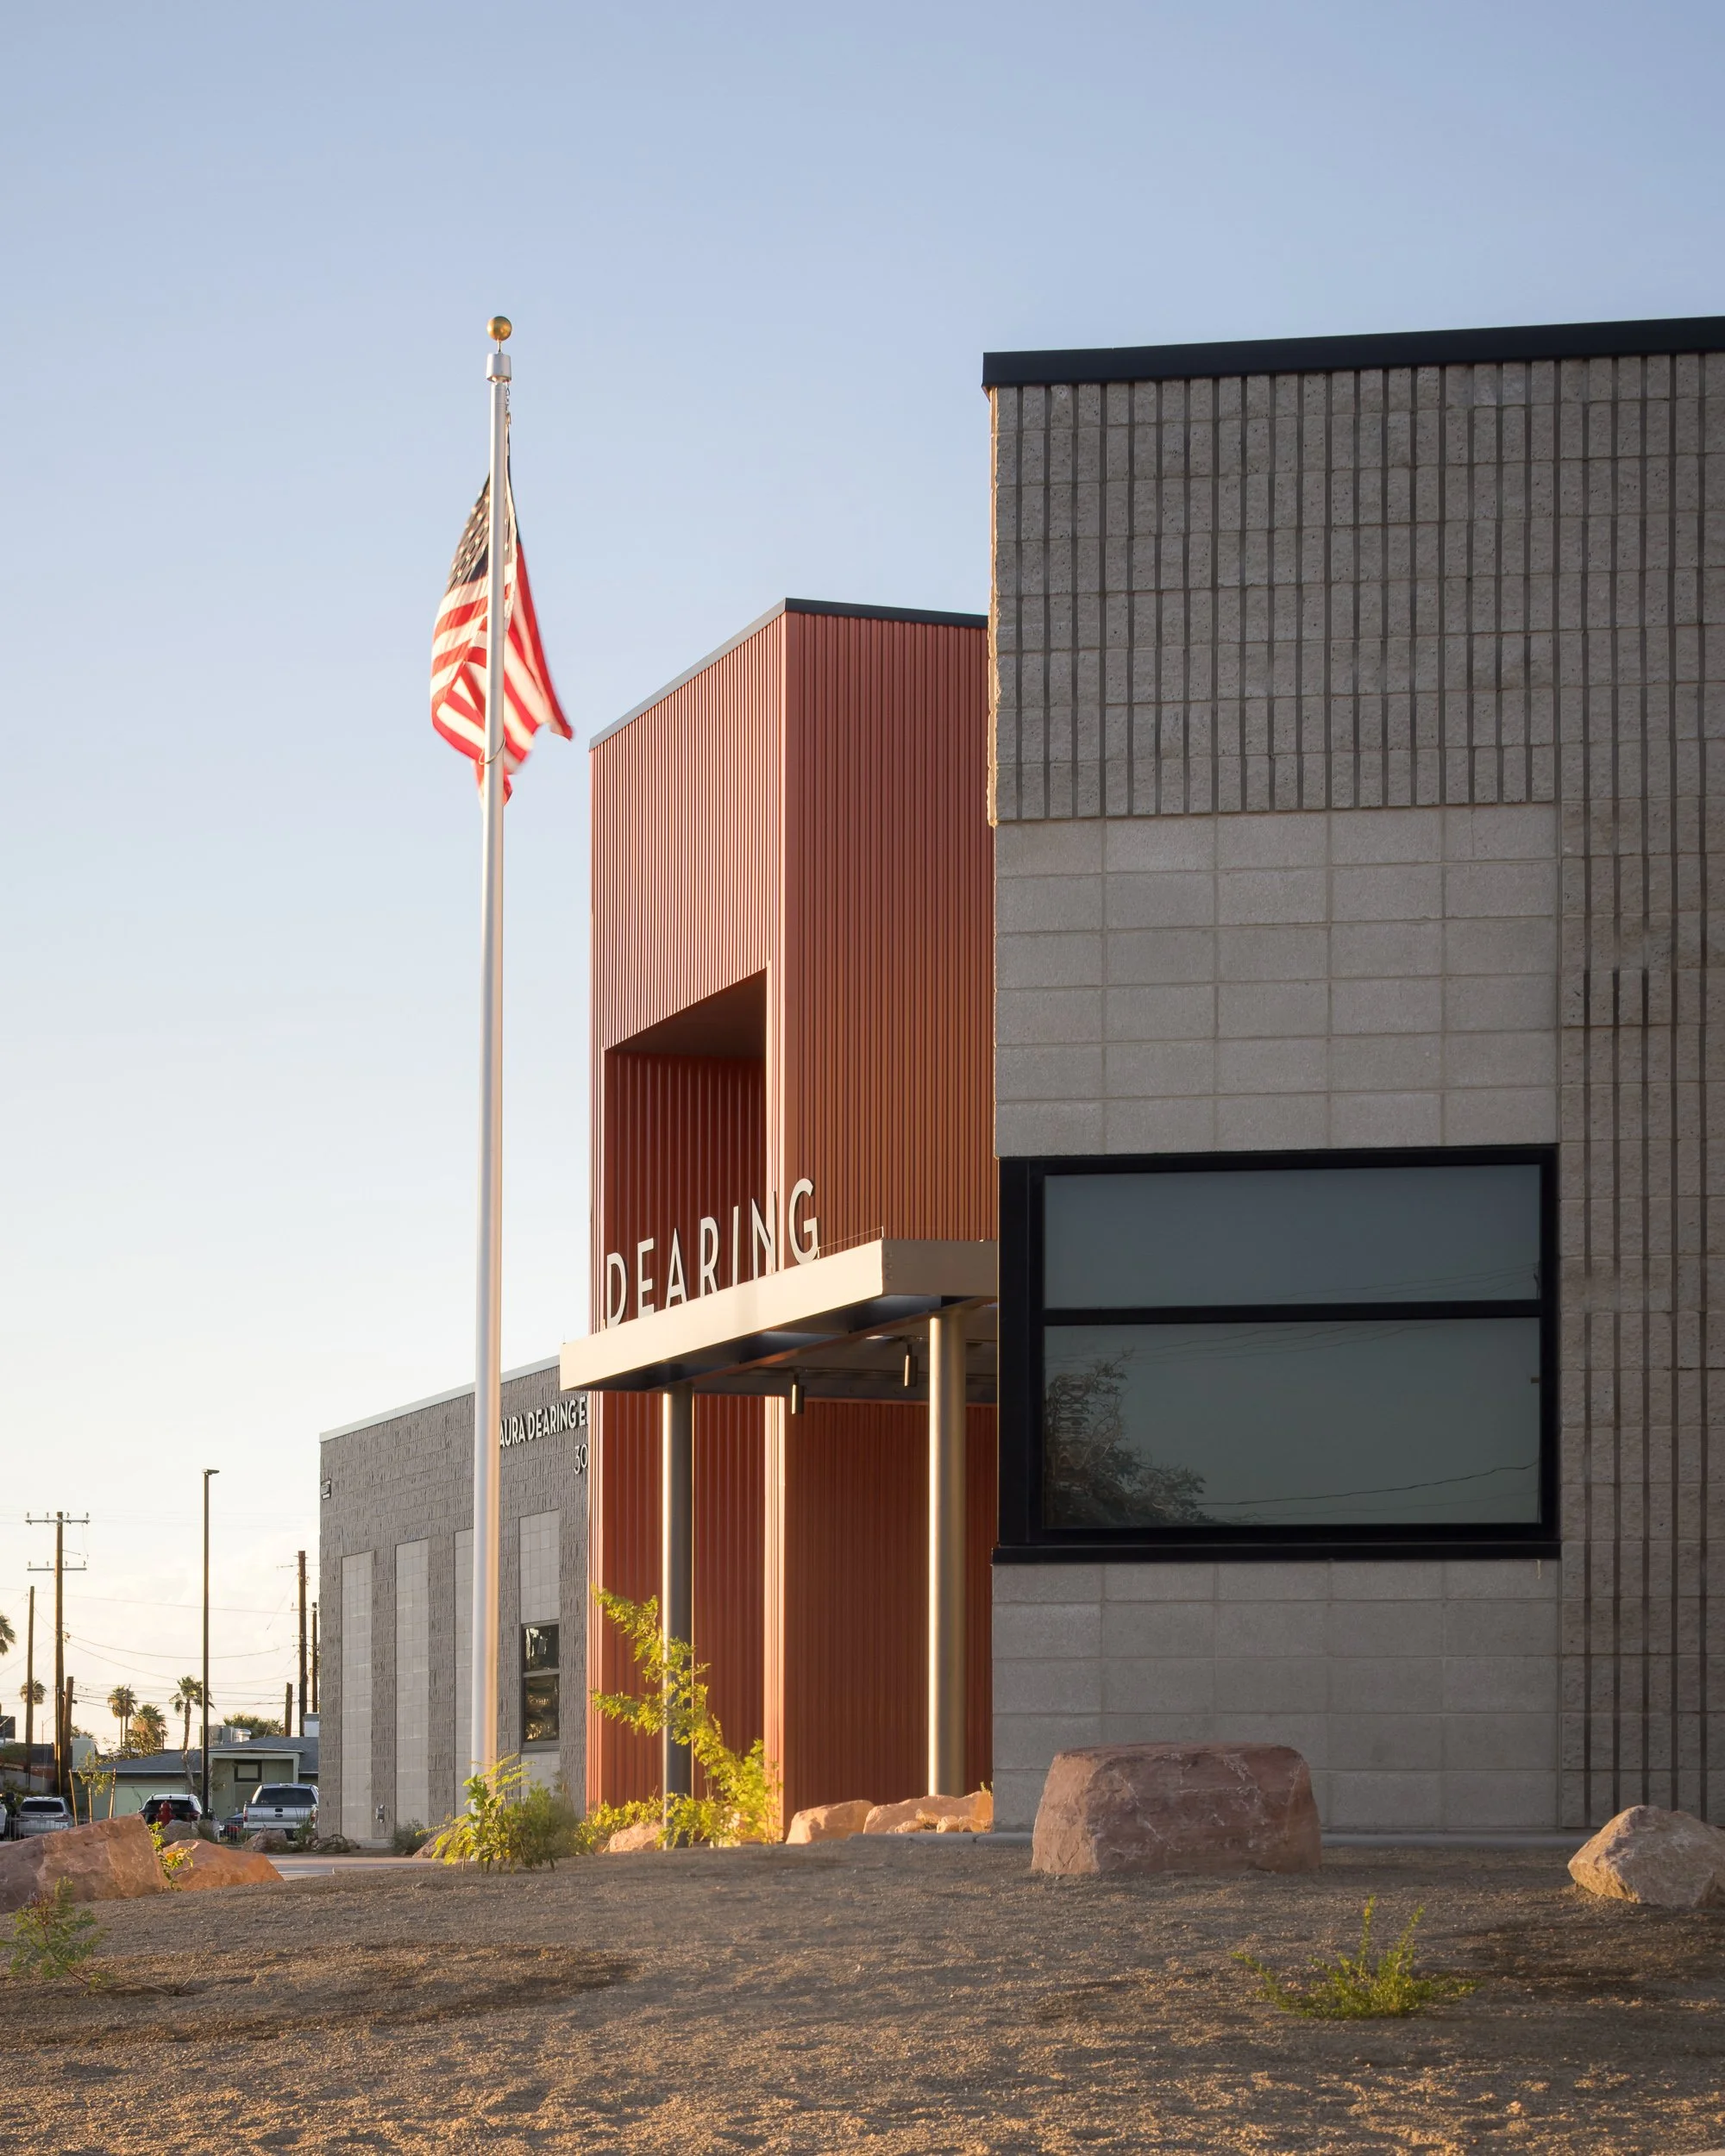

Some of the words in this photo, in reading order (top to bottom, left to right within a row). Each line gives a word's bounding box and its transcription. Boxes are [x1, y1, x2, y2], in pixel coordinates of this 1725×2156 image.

[606, 1177, 819, 1327] DEARING
[499, 1414, 526, 1448] AURA
[528, 1399, 577, 1440] DEARING
[579, 1395, 589, 1426] E
[574, 1444, 588, 1475] 30
